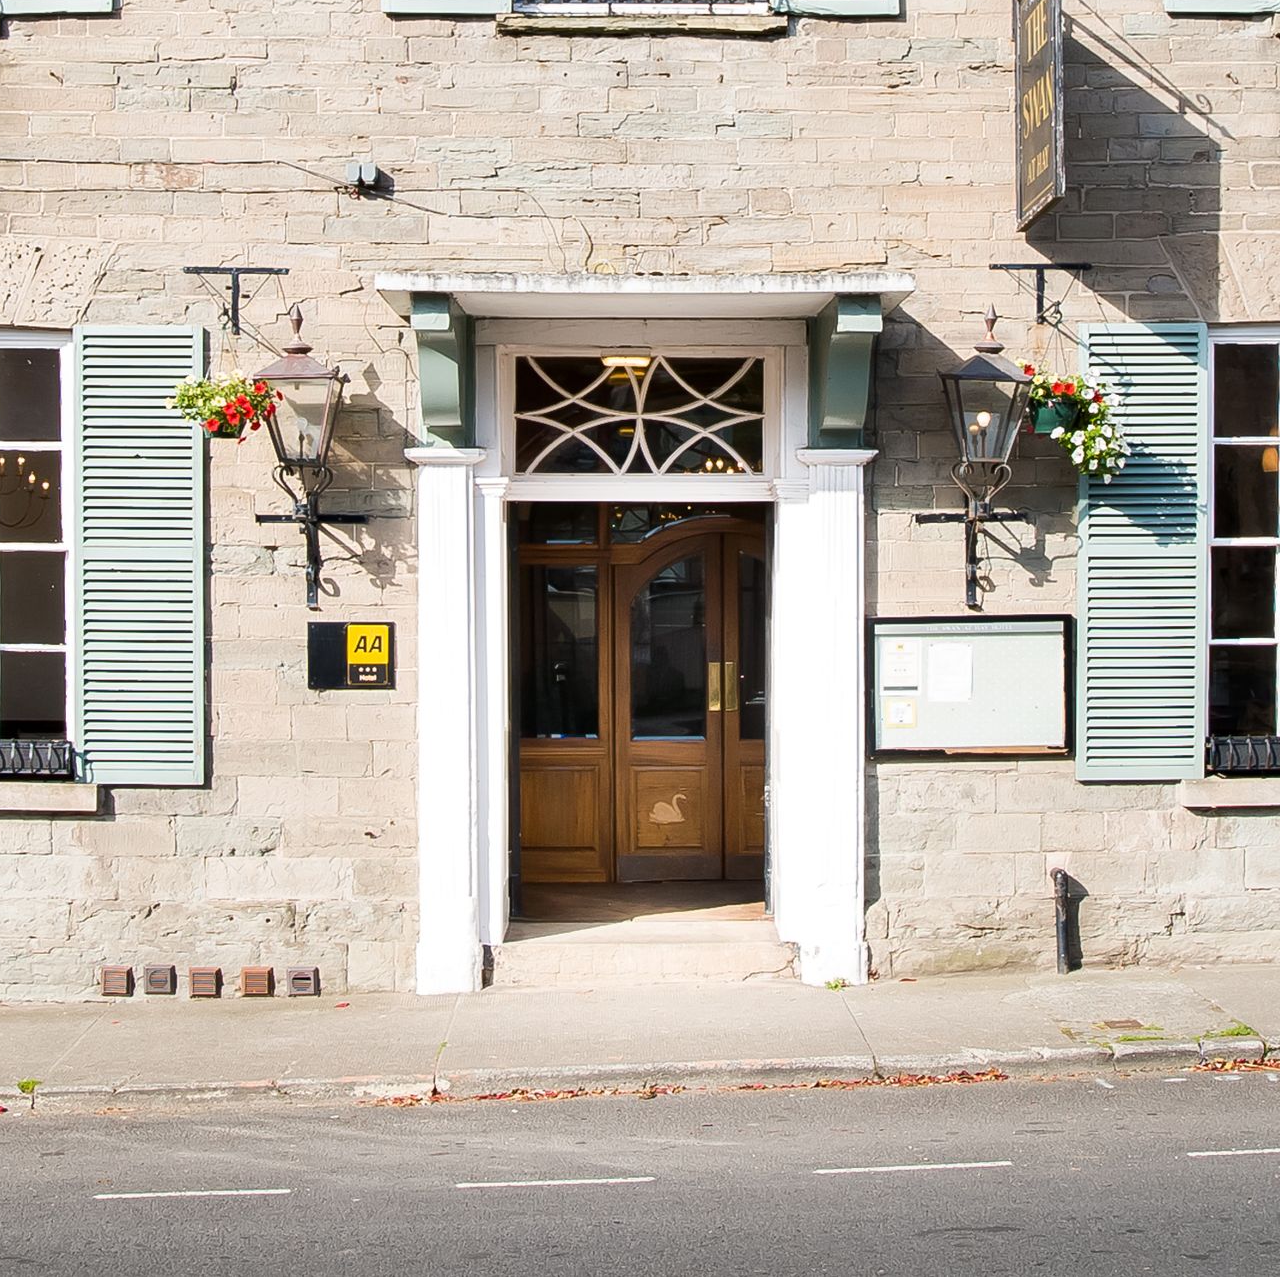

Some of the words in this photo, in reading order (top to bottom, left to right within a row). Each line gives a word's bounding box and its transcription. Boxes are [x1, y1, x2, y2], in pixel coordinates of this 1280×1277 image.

[1023, 65, 1054, 139] SWAN
[1026, 157, 1036, 186] AT
[1036, 144, 1049, 177] HAY
[354, 635, 382, 653] AA
